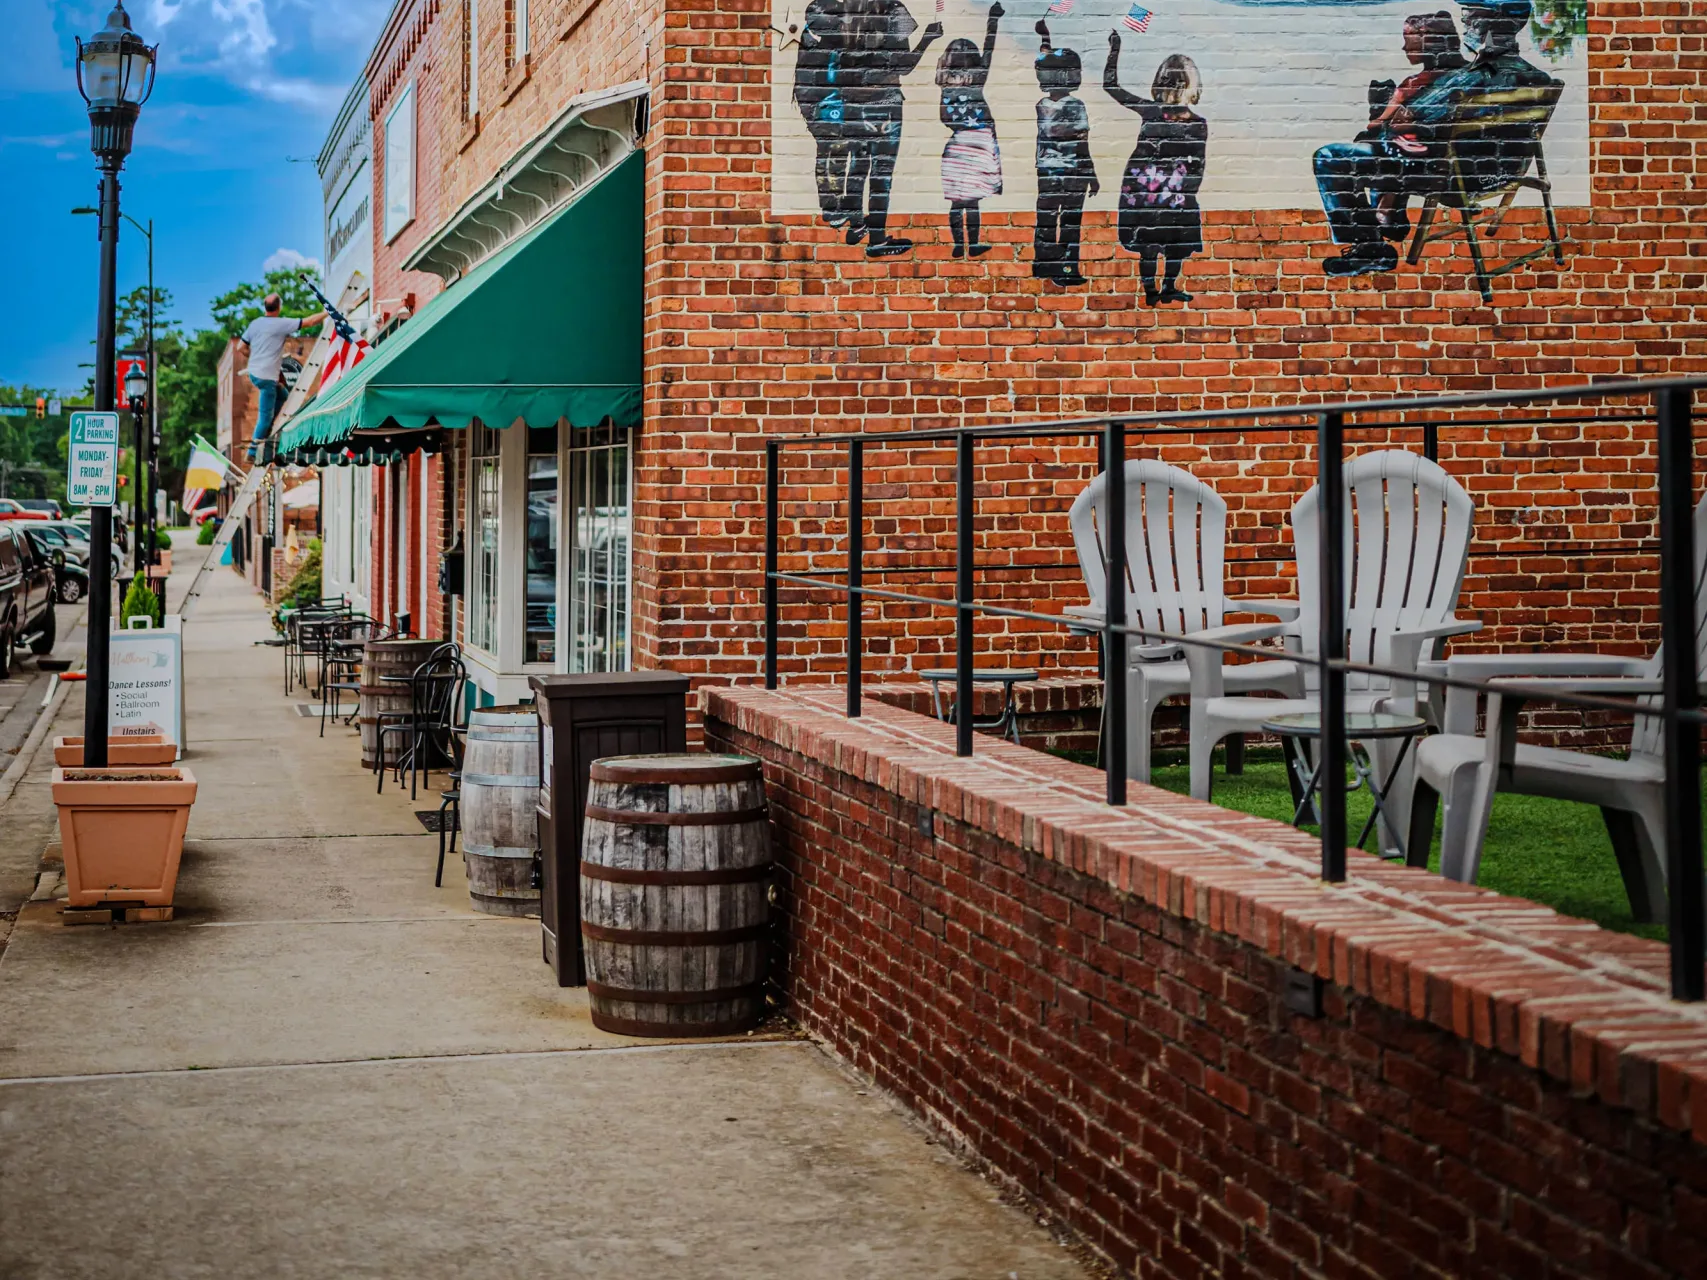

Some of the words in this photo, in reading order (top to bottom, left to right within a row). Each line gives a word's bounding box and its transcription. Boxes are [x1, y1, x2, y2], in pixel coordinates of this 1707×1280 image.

[75, 417, 83, 440] 2
[87, 418, 104, 428] HOUR
[86, 429, 114, 439] PARKING
[80, 466, 104, 478] FRIDAY
[73, 484, 88, 495] 8AM
[95, 485, 110, 496] 6PM
[109, 681, 133, 690] Dance
[135, 679, 171, 689] Lessons!
[120, 691, 148, 700] Social
[120, 700, 160, 709] Ballroom
[120, 709, 142, 718] Latin
